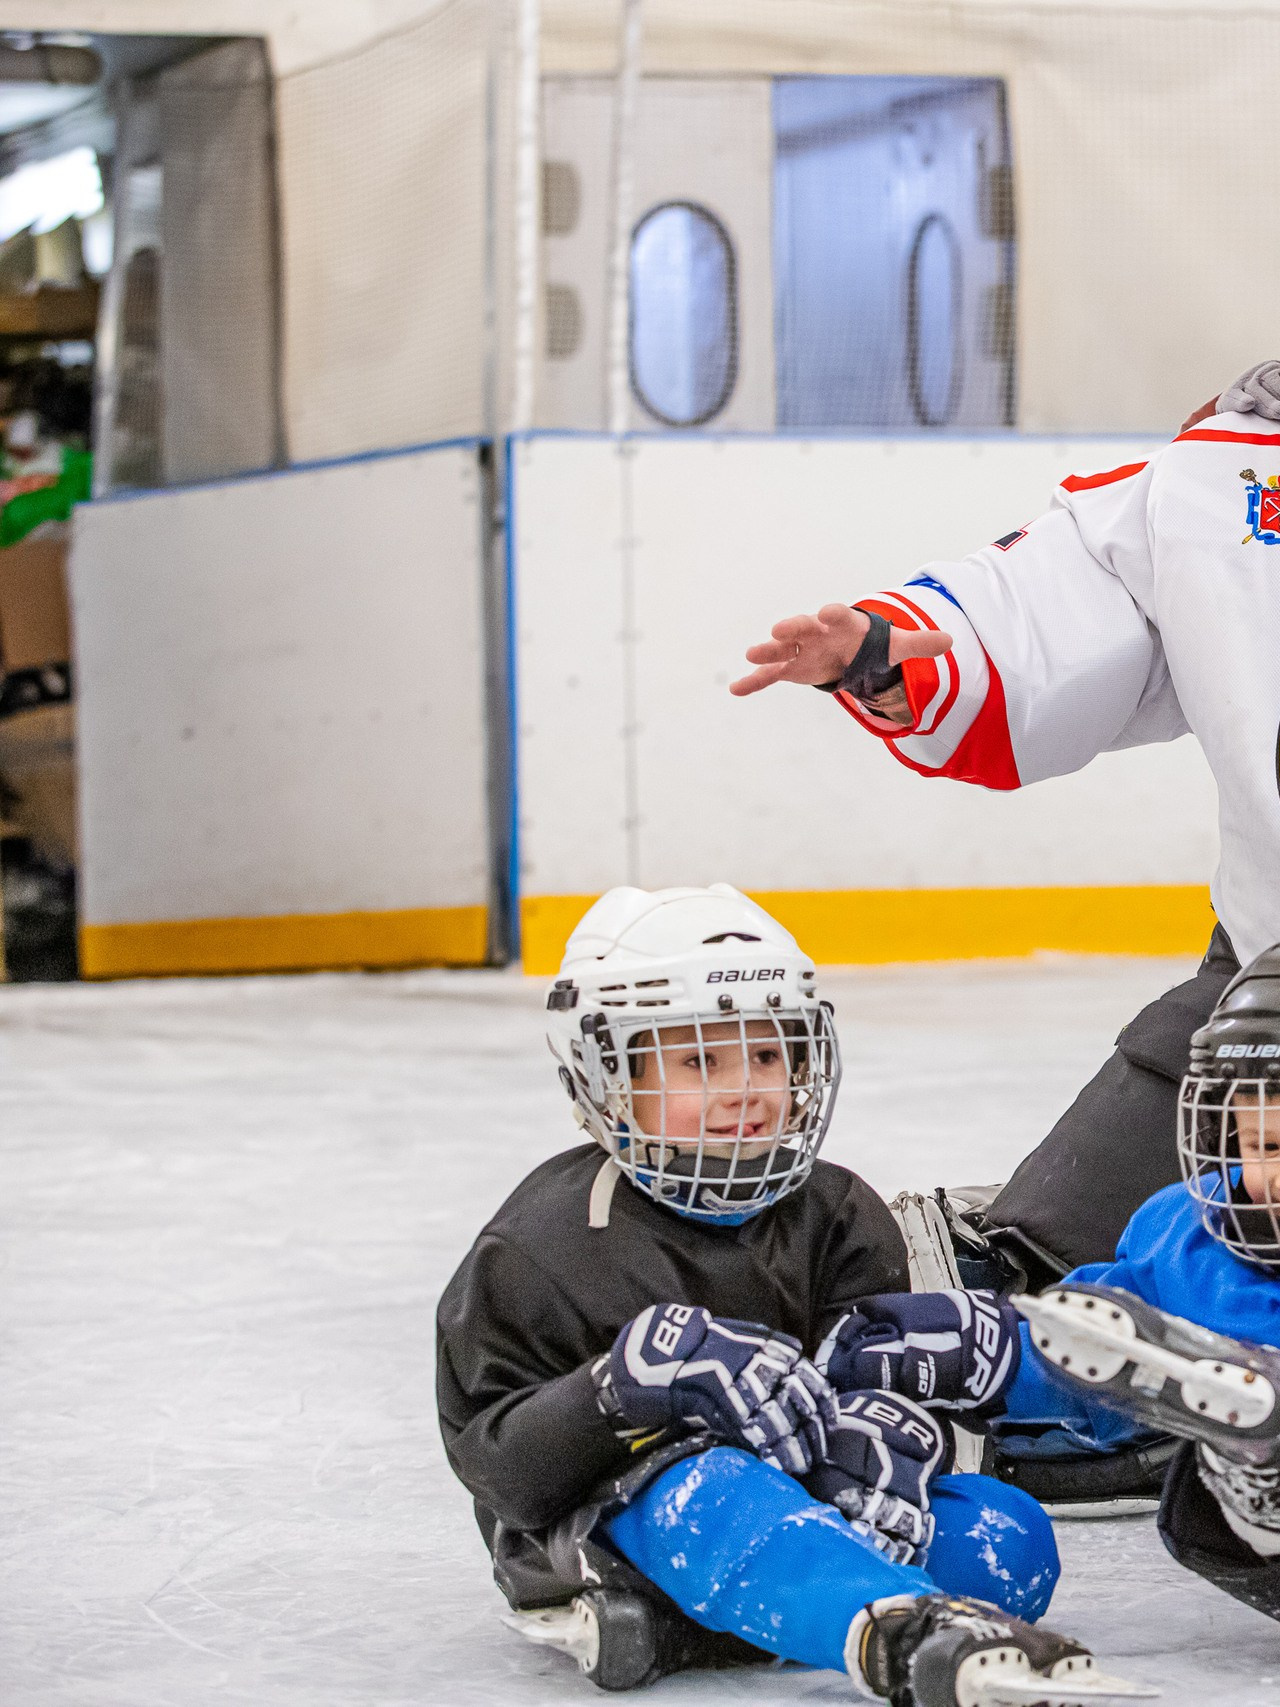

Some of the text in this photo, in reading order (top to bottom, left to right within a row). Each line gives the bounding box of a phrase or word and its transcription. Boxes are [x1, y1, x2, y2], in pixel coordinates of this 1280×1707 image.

[706, 968, 786, 984] BAUER
[964, 1289, 1001, 1397] UER
[840, 1396, 935, 1451] UER
